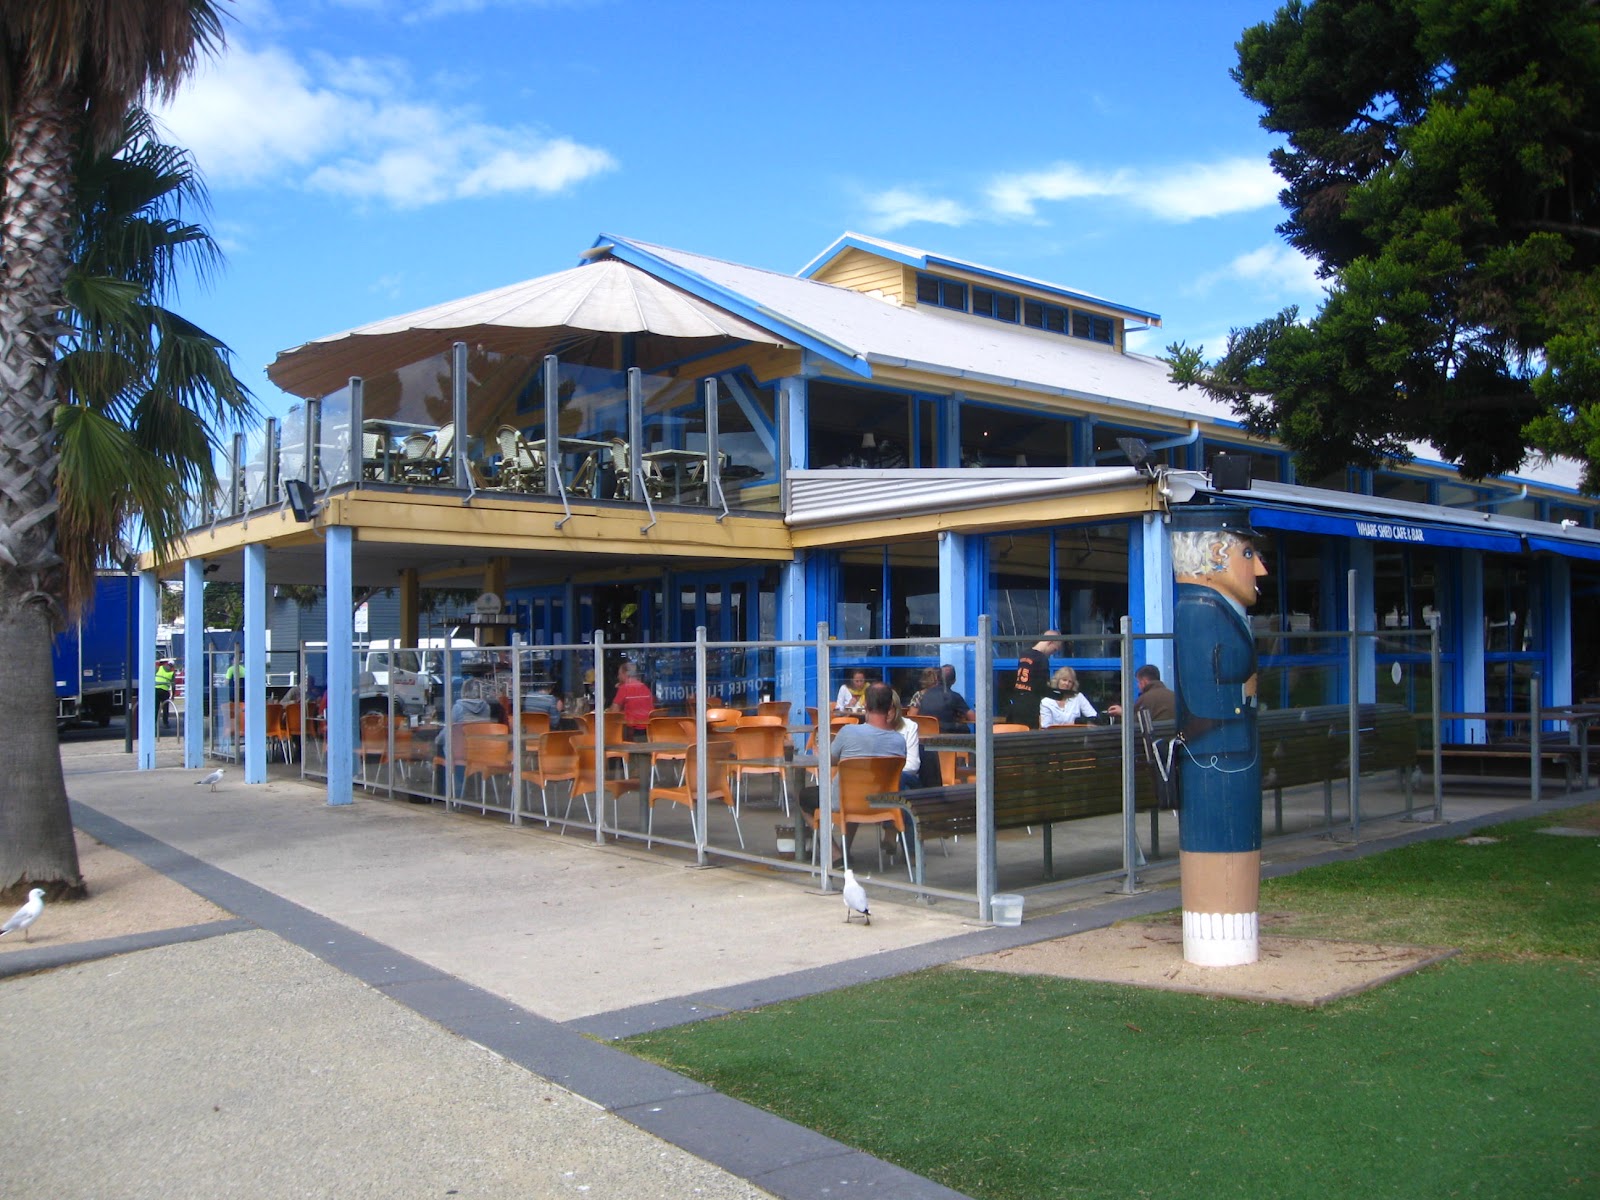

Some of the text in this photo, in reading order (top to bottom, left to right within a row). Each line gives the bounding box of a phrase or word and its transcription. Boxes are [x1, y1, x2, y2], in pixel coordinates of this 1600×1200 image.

[1355, 522, 1377, 537] WHARF
[1378, 524, 1392, 538] SHED
[1411, 528, 1424, 541] BAR
